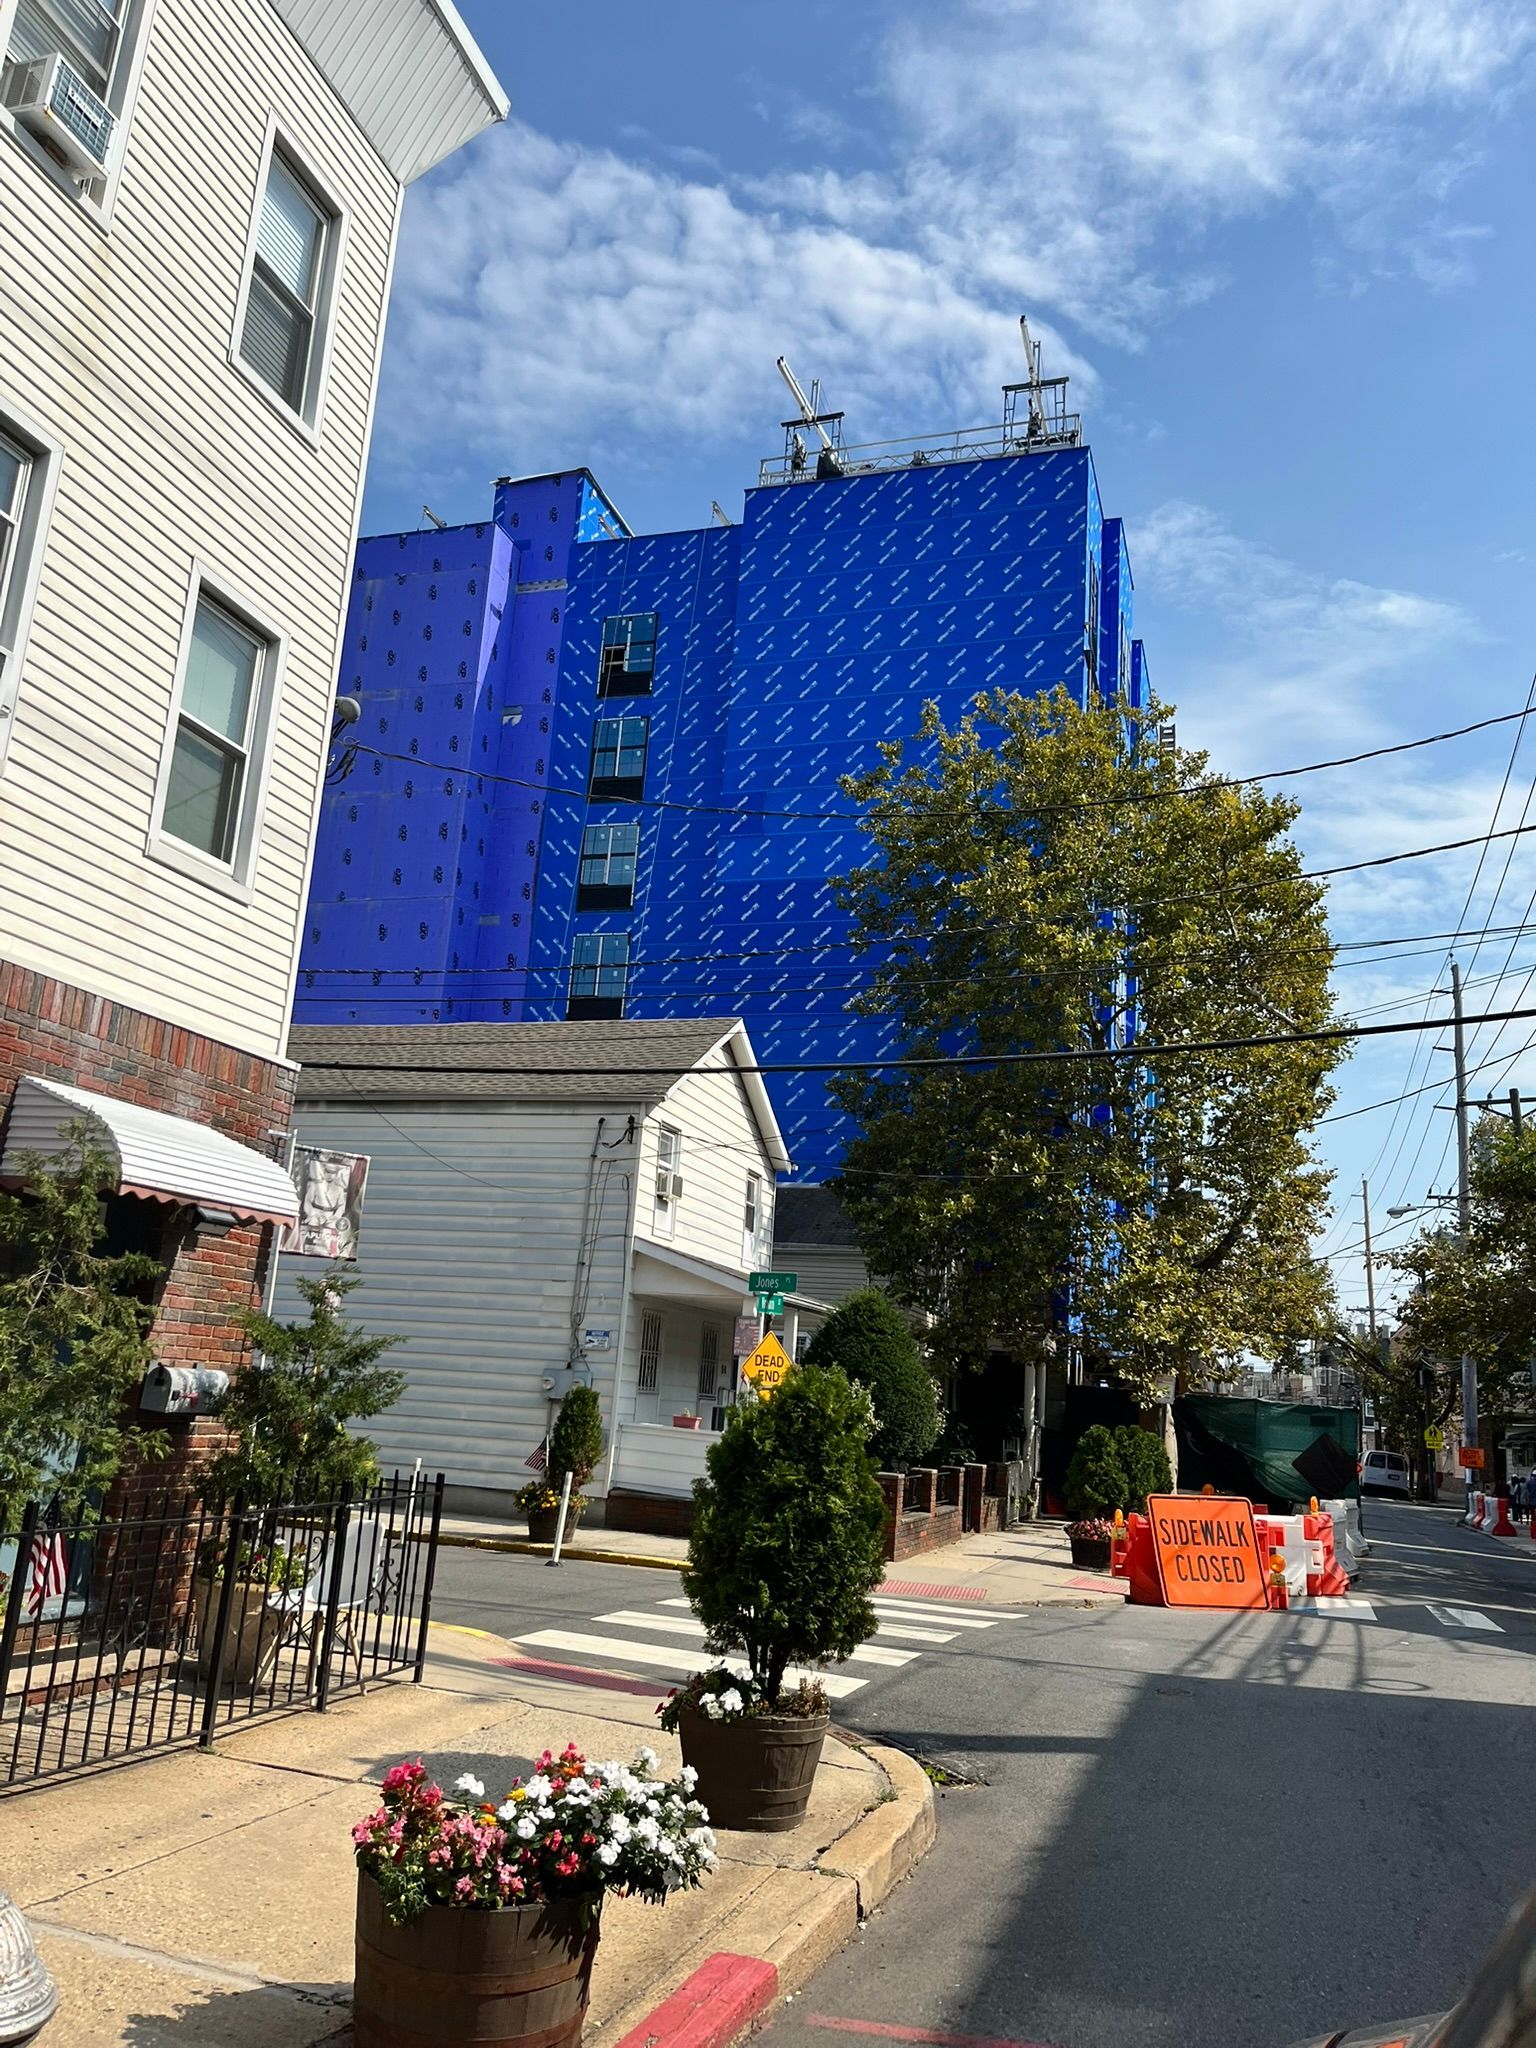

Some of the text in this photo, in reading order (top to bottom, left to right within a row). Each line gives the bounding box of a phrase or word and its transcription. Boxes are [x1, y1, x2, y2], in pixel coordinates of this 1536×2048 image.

[755, 1276, 780, 1289] Jones
[755, 1354, 784, 1368] DEAD
[758, 1369, 780, 1383] END
[1159, 1518, 1250, 1548] SIDEWALK
[1176, 1554, 1246, 1584] CLOSED
